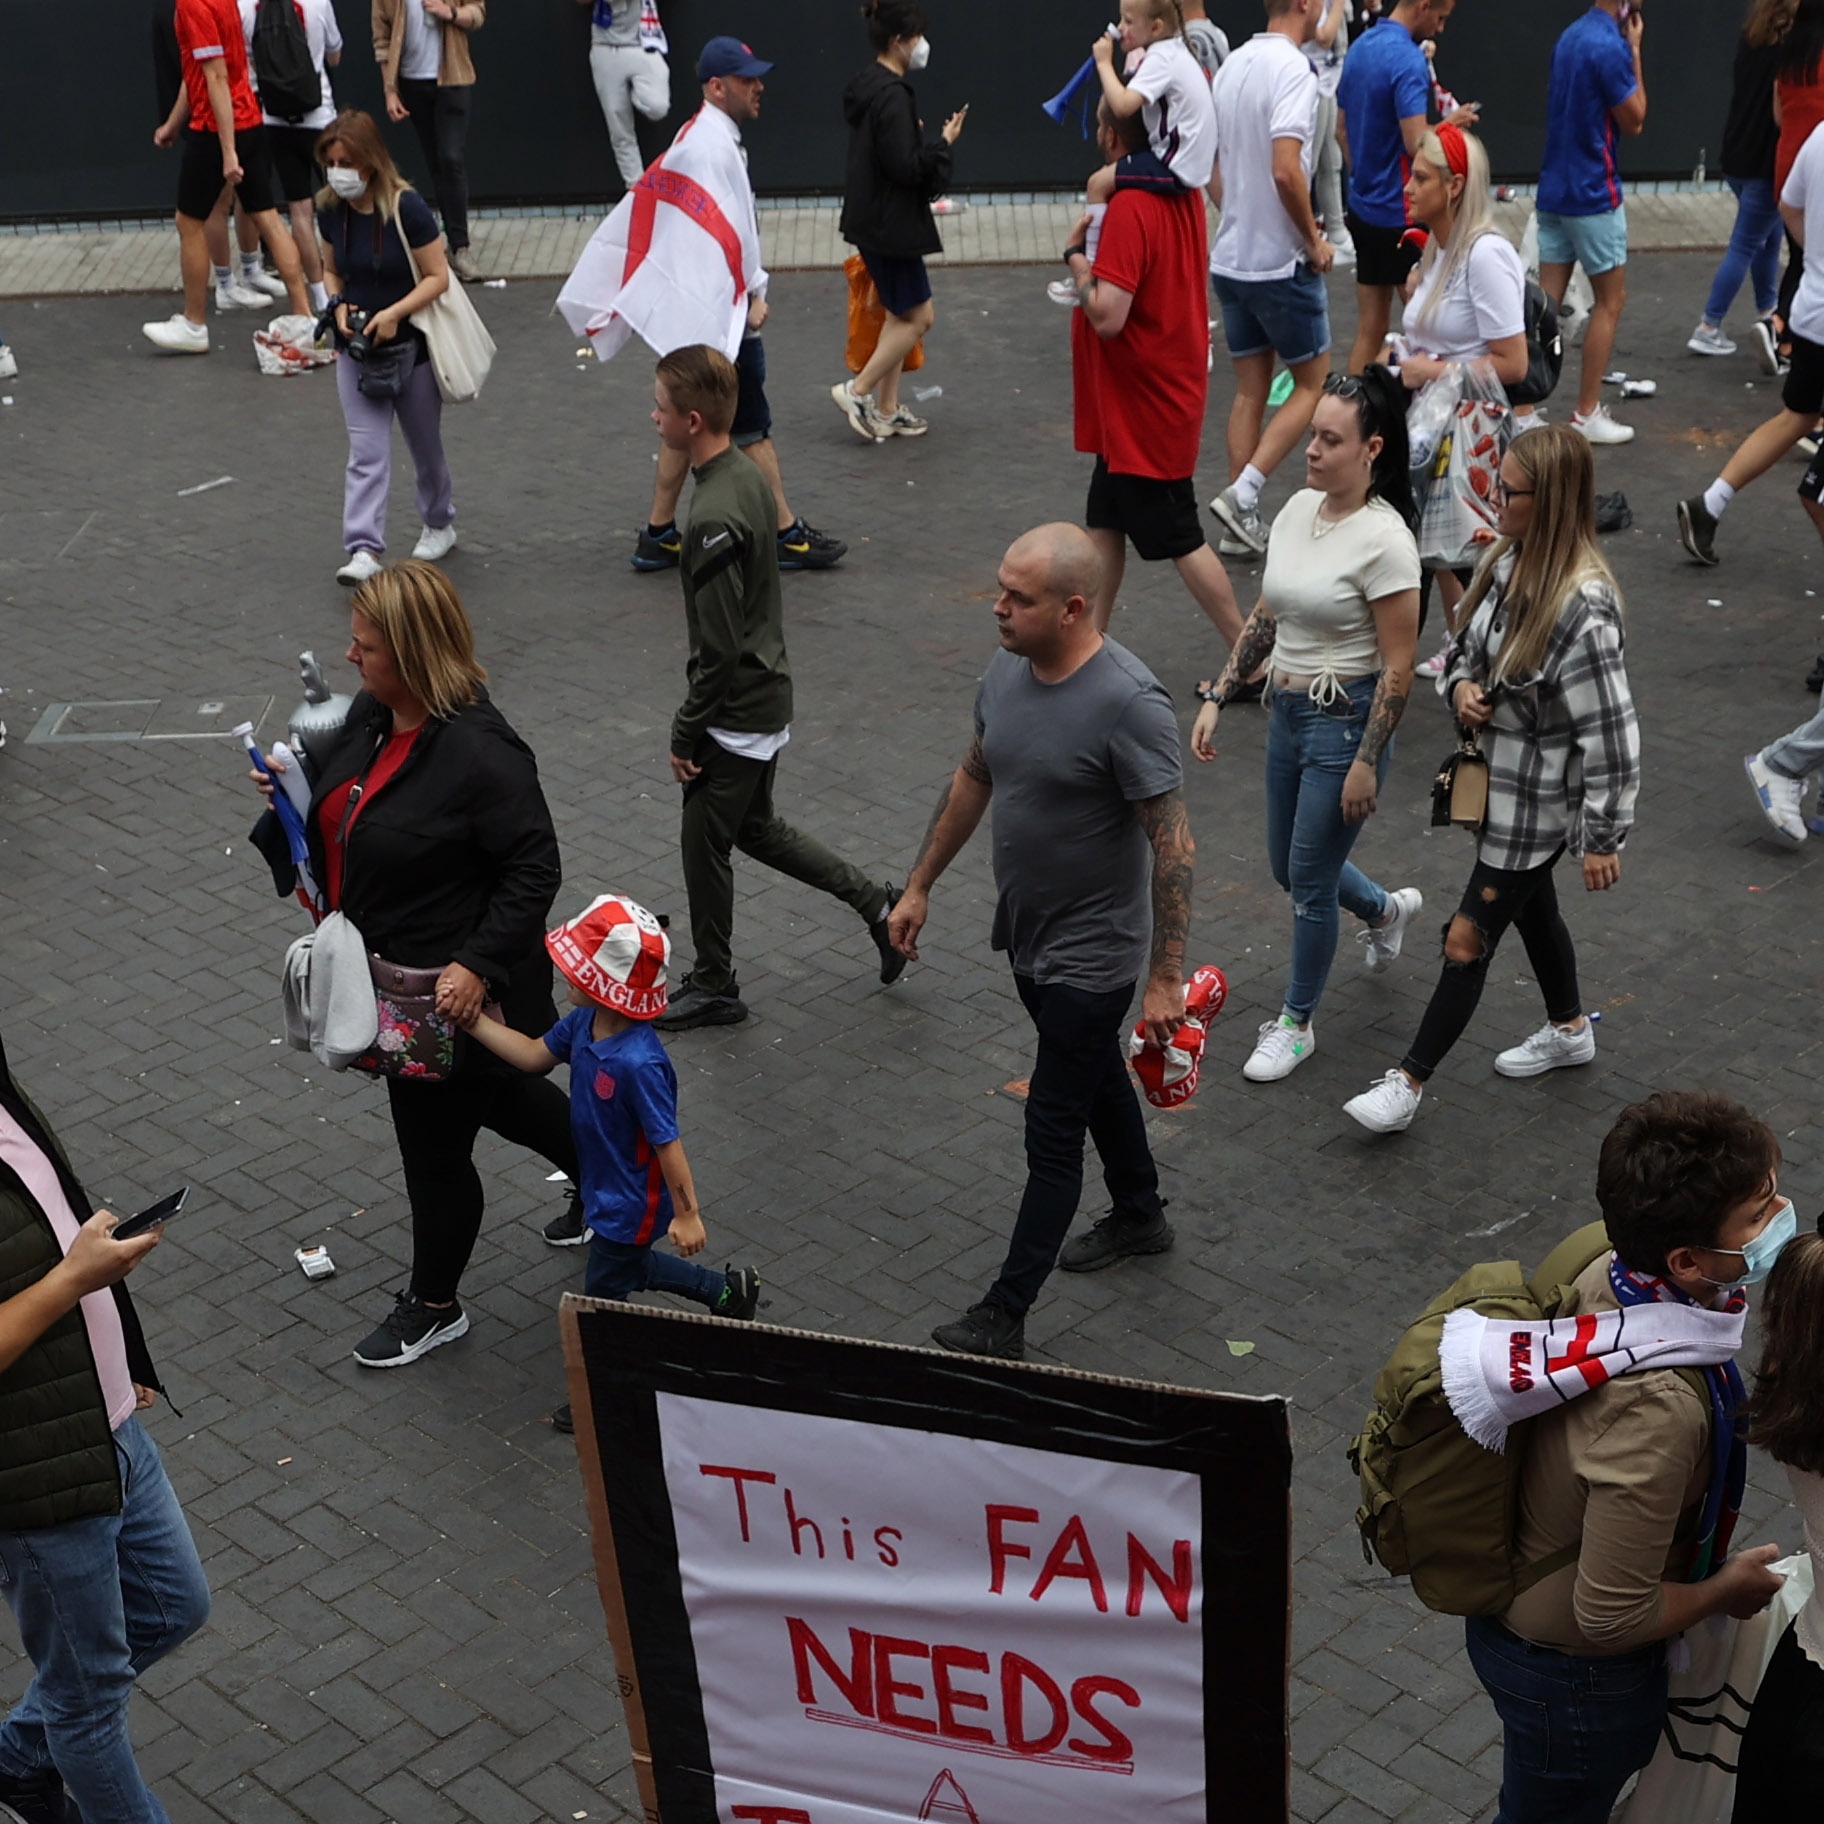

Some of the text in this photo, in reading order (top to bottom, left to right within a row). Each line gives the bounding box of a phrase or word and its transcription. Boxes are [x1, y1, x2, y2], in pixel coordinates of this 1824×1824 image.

[573, 957, 669, 1014] ENGLAN
[700, 1463, 1193, 1624] This FAN
[784, 1616, 1142, 1761] NEEDS
